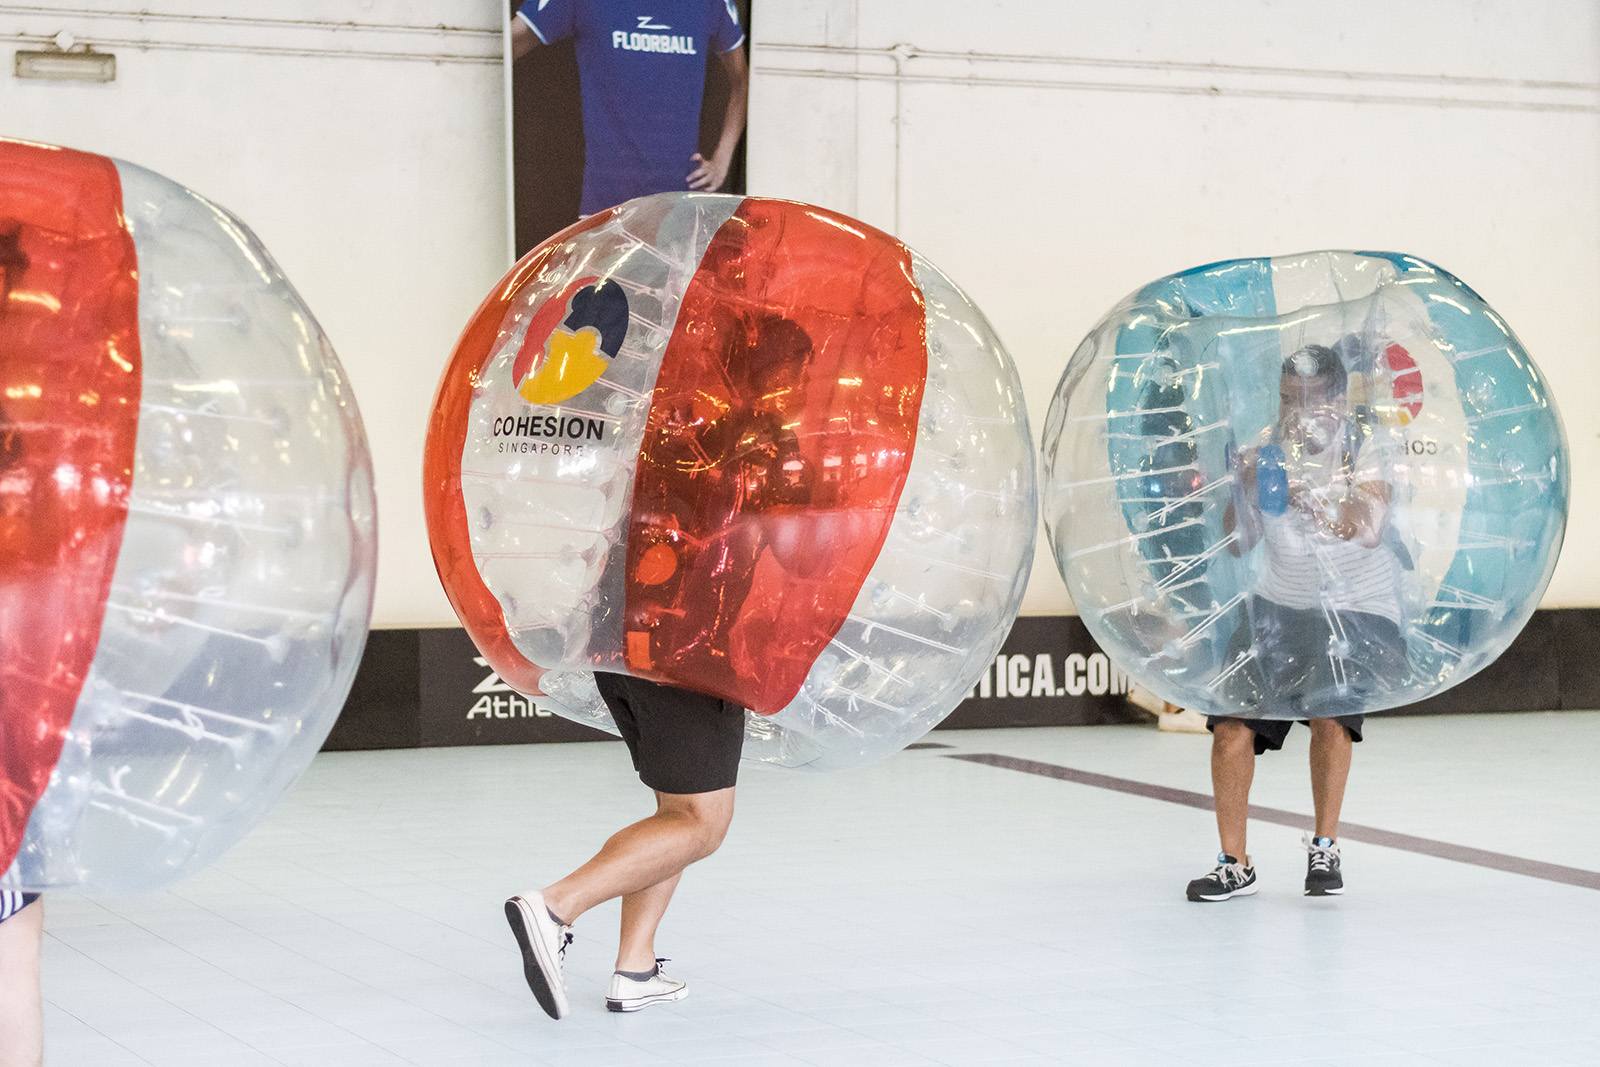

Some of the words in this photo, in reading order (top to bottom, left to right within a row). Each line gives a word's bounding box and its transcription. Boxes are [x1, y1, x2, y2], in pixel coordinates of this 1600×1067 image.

[612, 30, 697, 55] FLOORBALL
[493, 416, 605, 440] COHESION
[964, 653, 1129, 698] TICA.COM
